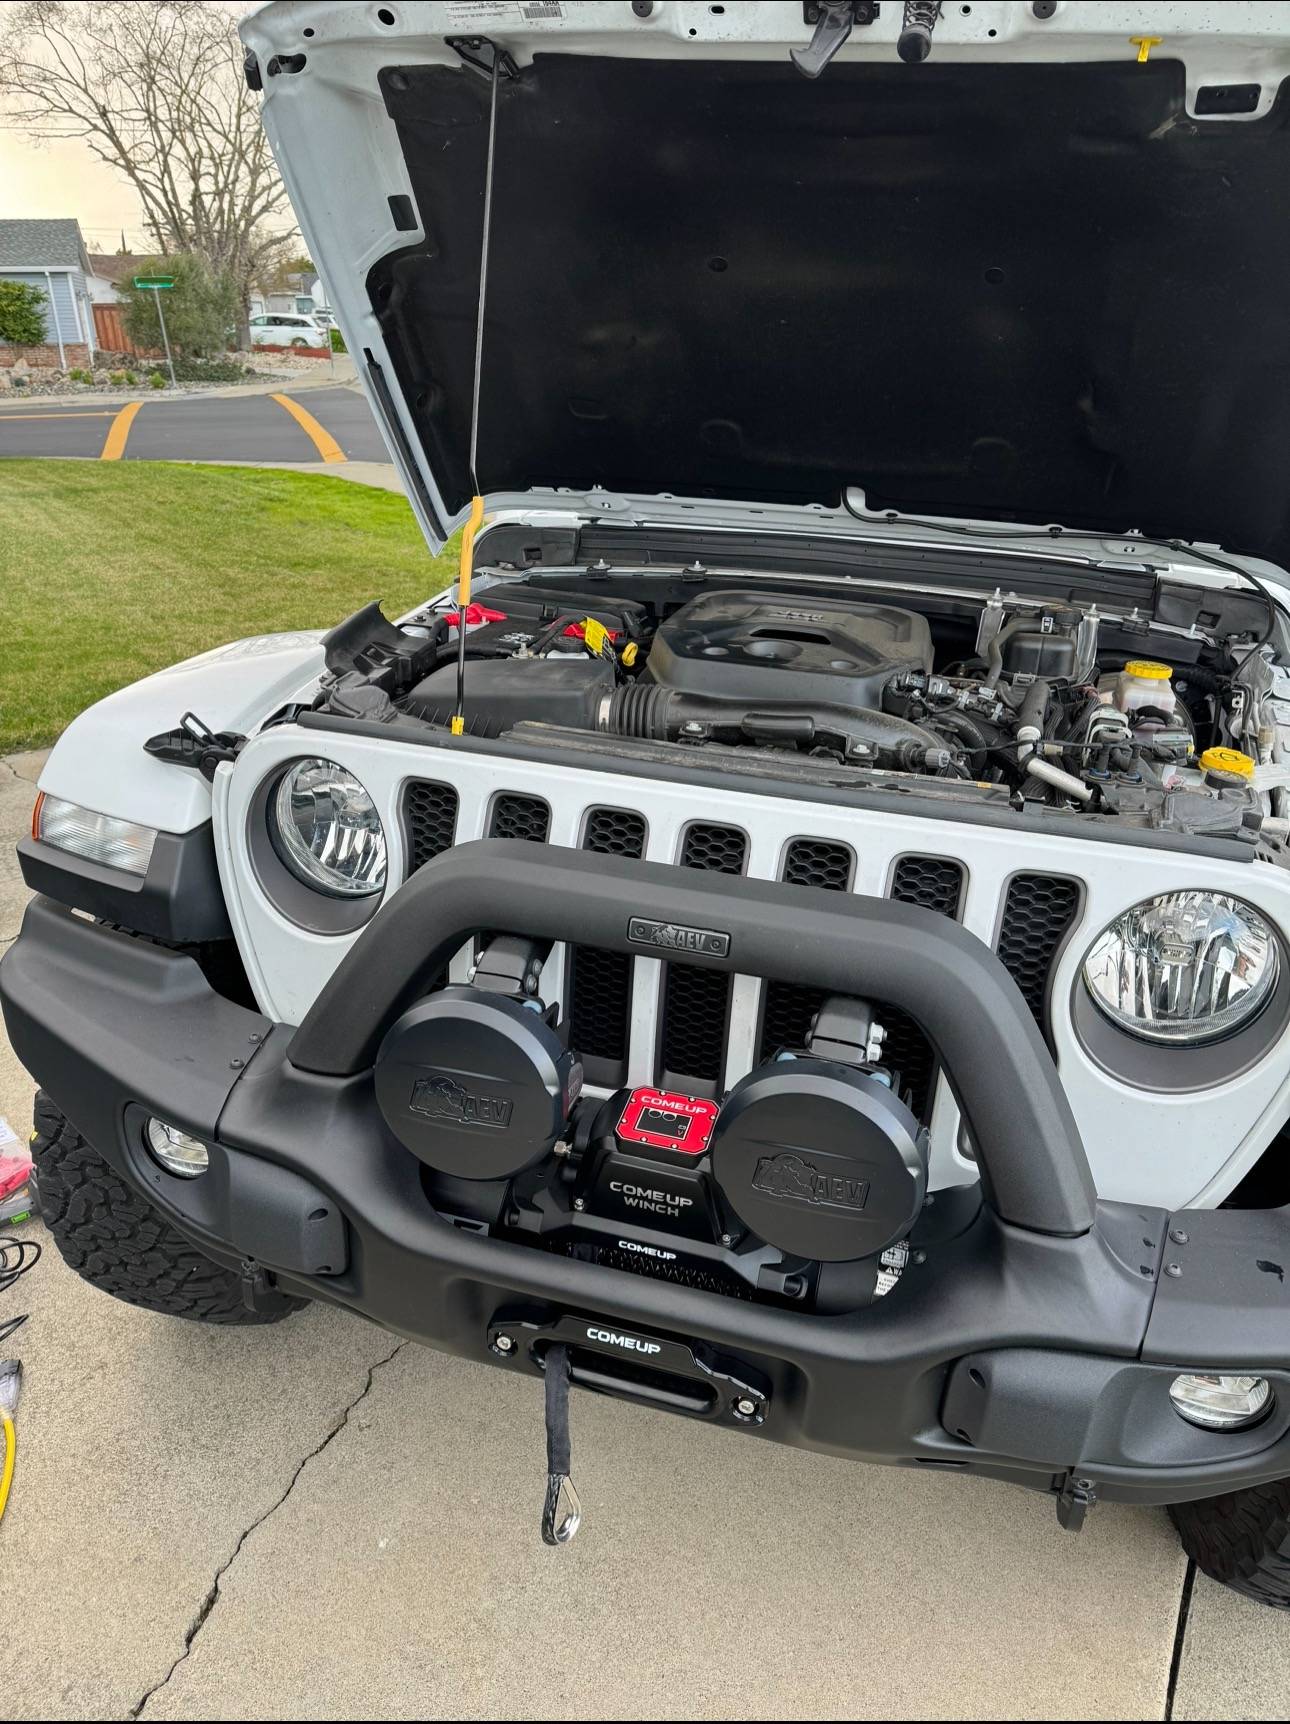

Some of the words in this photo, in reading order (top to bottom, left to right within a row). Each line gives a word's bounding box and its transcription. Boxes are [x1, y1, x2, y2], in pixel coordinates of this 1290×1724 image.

[676, 930, 706, 950] AEV
[463, 1095, 511, 1123] AEV
[641, 1095, 707, 1114] COMEUP
[609, 1181, 693, 1207] COMEUP
[813, 1174, 867, 1207] AEV
[623, 1196, 679, 1217] WINCH
[618, 1240, 677, 1260] COMEUP
[586, 1327, 661, 1354] COMEUP
